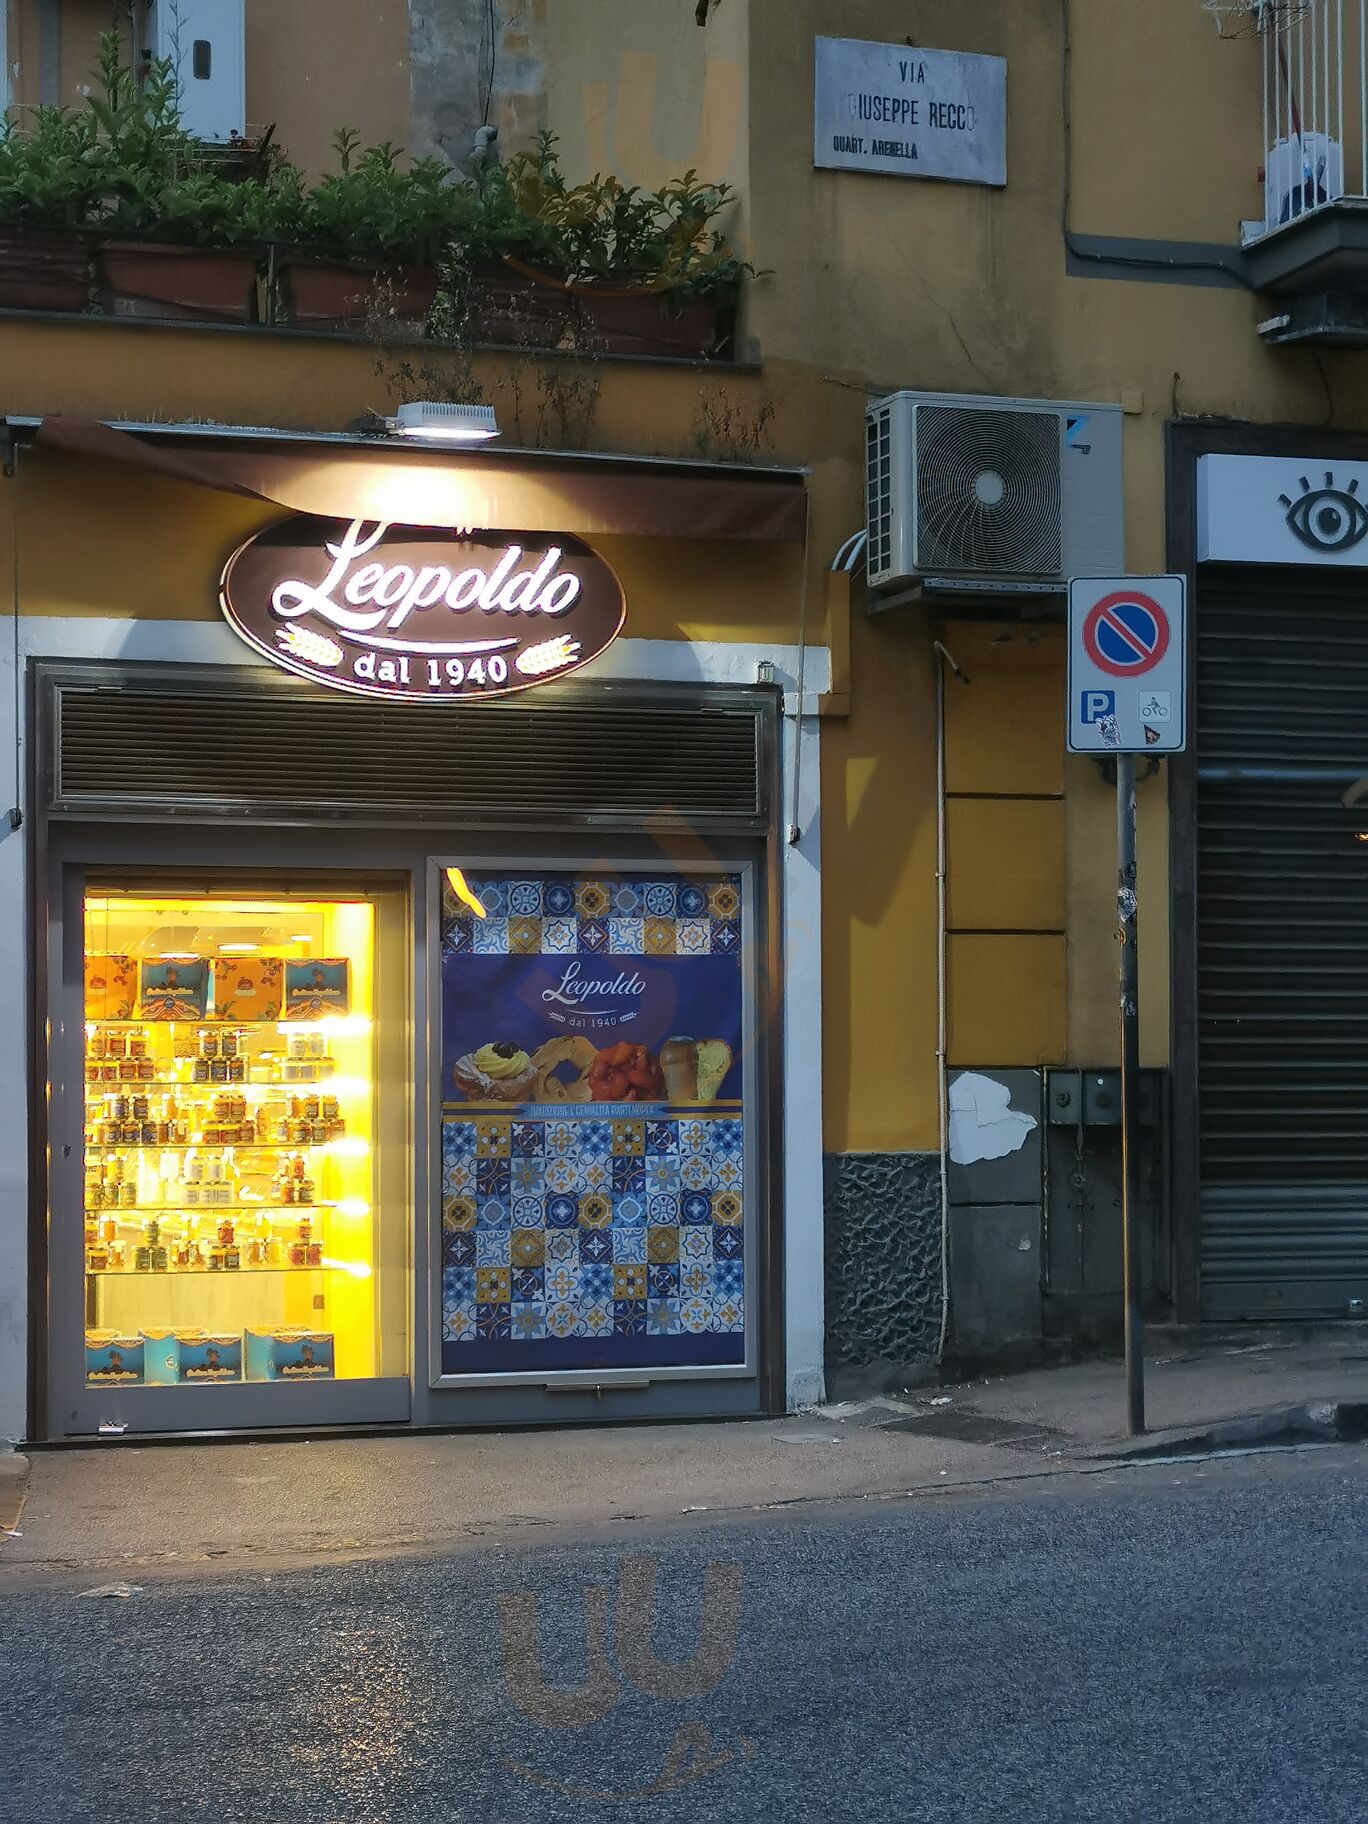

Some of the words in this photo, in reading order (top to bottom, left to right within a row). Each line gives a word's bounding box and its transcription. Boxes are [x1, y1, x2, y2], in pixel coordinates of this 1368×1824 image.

[899, 61, 925, 84] VIA
[929, 102, 975, 131] RECCO
[833, 136, 867, 155] QUART.
[872, 139, 918, 160] ARENELLA
[272, 519, 580, 630] Leopoldo
[353, 653, 409, 684] dal
[428, 655, 508, 687] 1940
[1087, 693, 1110, 721] P
[541, 961, 647, 1005] Leopoldo
[569, 1018, 586, 1028] dal
[591, 1017, 617, 1028] 1940
